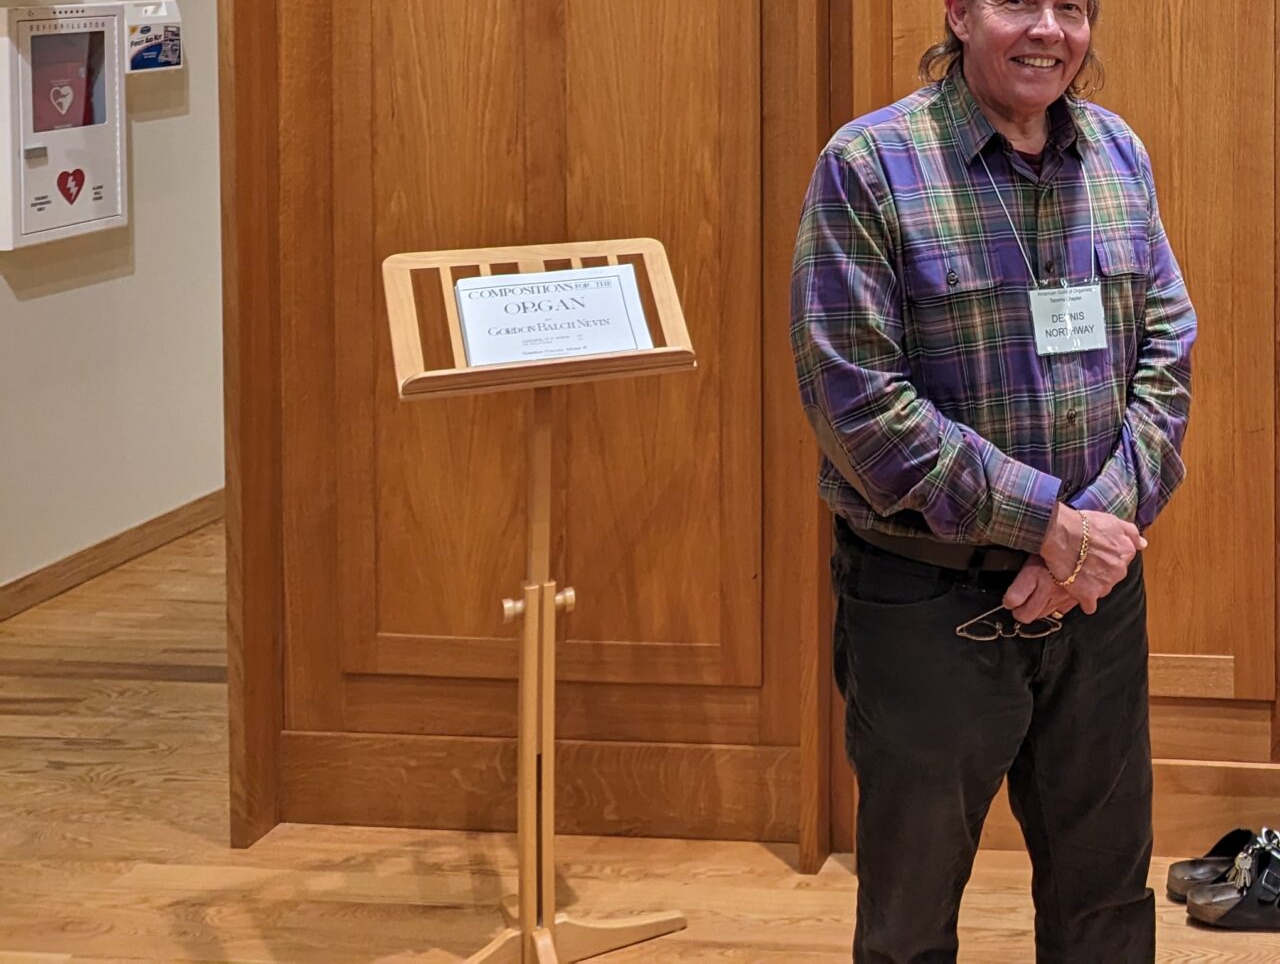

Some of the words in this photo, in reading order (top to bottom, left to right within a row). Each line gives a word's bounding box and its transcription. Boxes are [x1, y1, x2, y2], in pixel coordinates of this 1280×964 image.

[468, 283, 574, 300] COMPOSITIONS
[504, 296, 585, 315] ORGAN
[577, 318, 611, 329] NEVIN
[1051, 311, 1085, 323] DENIS
